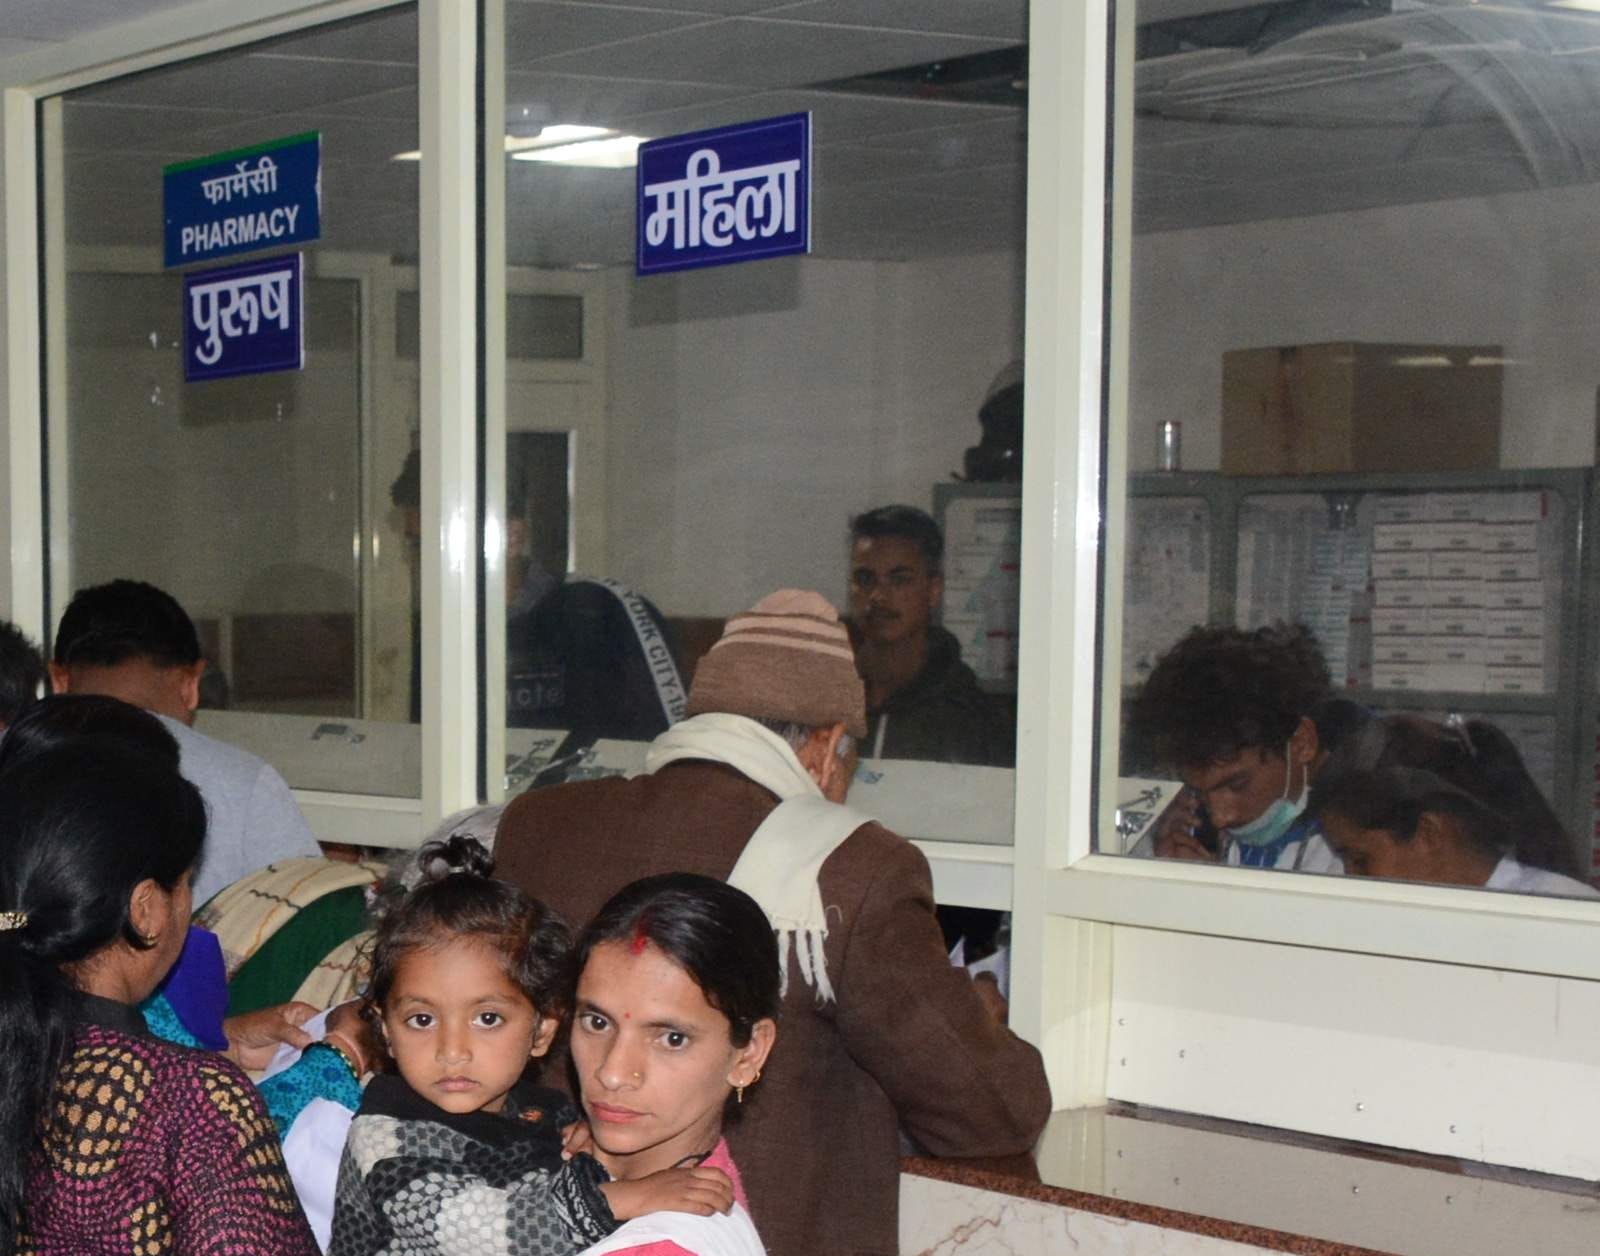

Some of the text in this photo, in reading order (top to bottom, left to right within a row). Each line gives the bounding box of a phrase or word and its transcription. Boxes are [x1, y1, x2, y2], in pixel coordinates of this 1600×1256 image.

[201, 156, 278, 205] फार्मेसी
[645, 148, 800, 249] महिला
[181, 204, 299, 255] PHARMACY
